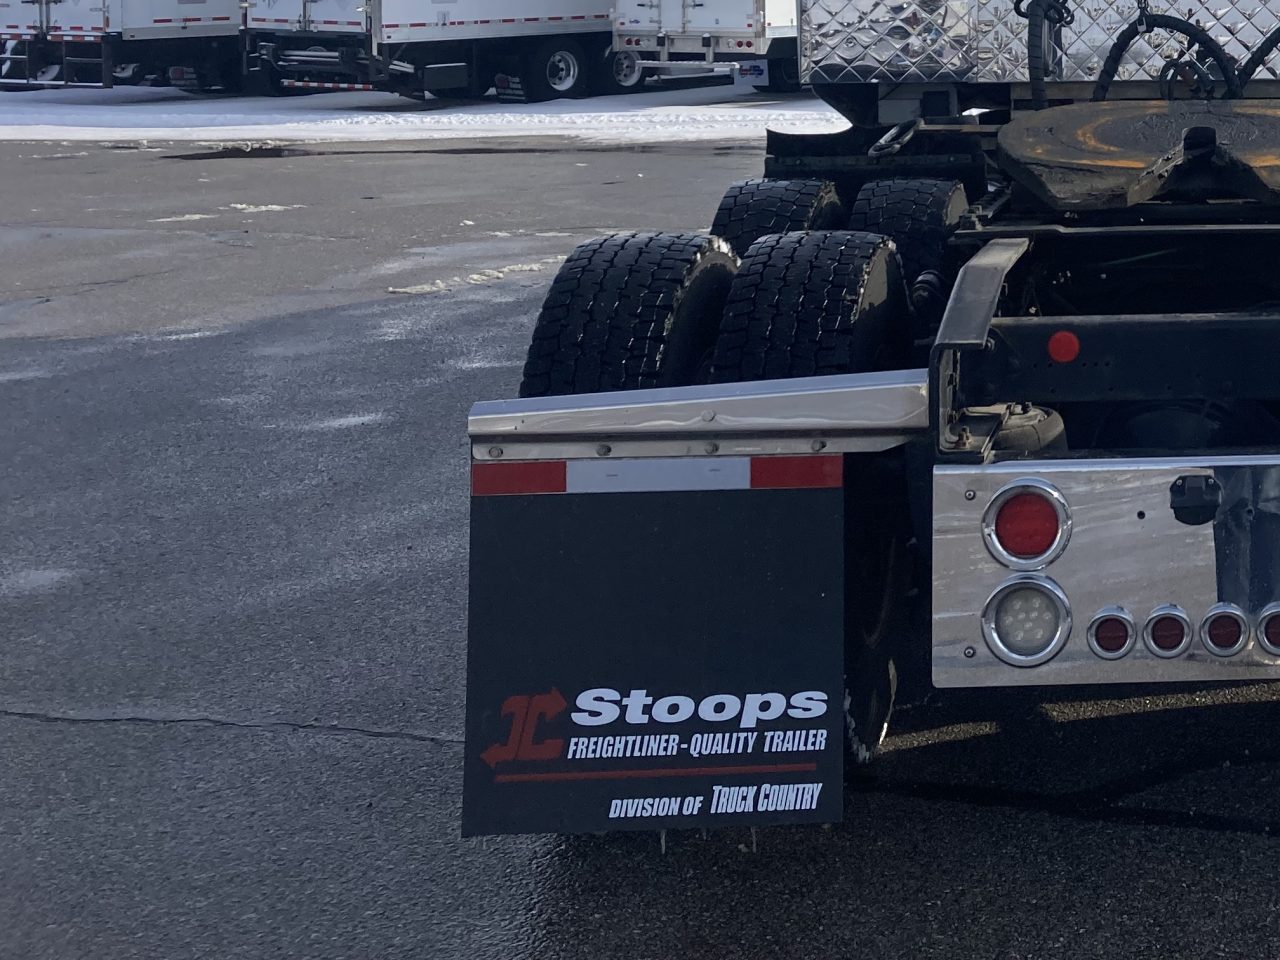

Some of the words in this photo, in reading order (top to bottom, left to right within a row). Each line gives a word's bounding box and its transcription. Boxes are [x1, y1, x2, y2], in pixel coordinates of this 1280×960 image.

[570, 688, 828, 728] Stoops
[764, 729, 828, 753] TRAILER
[608, 796, 681, 818] DIVISION
[682, 795, 704, 816] OF
